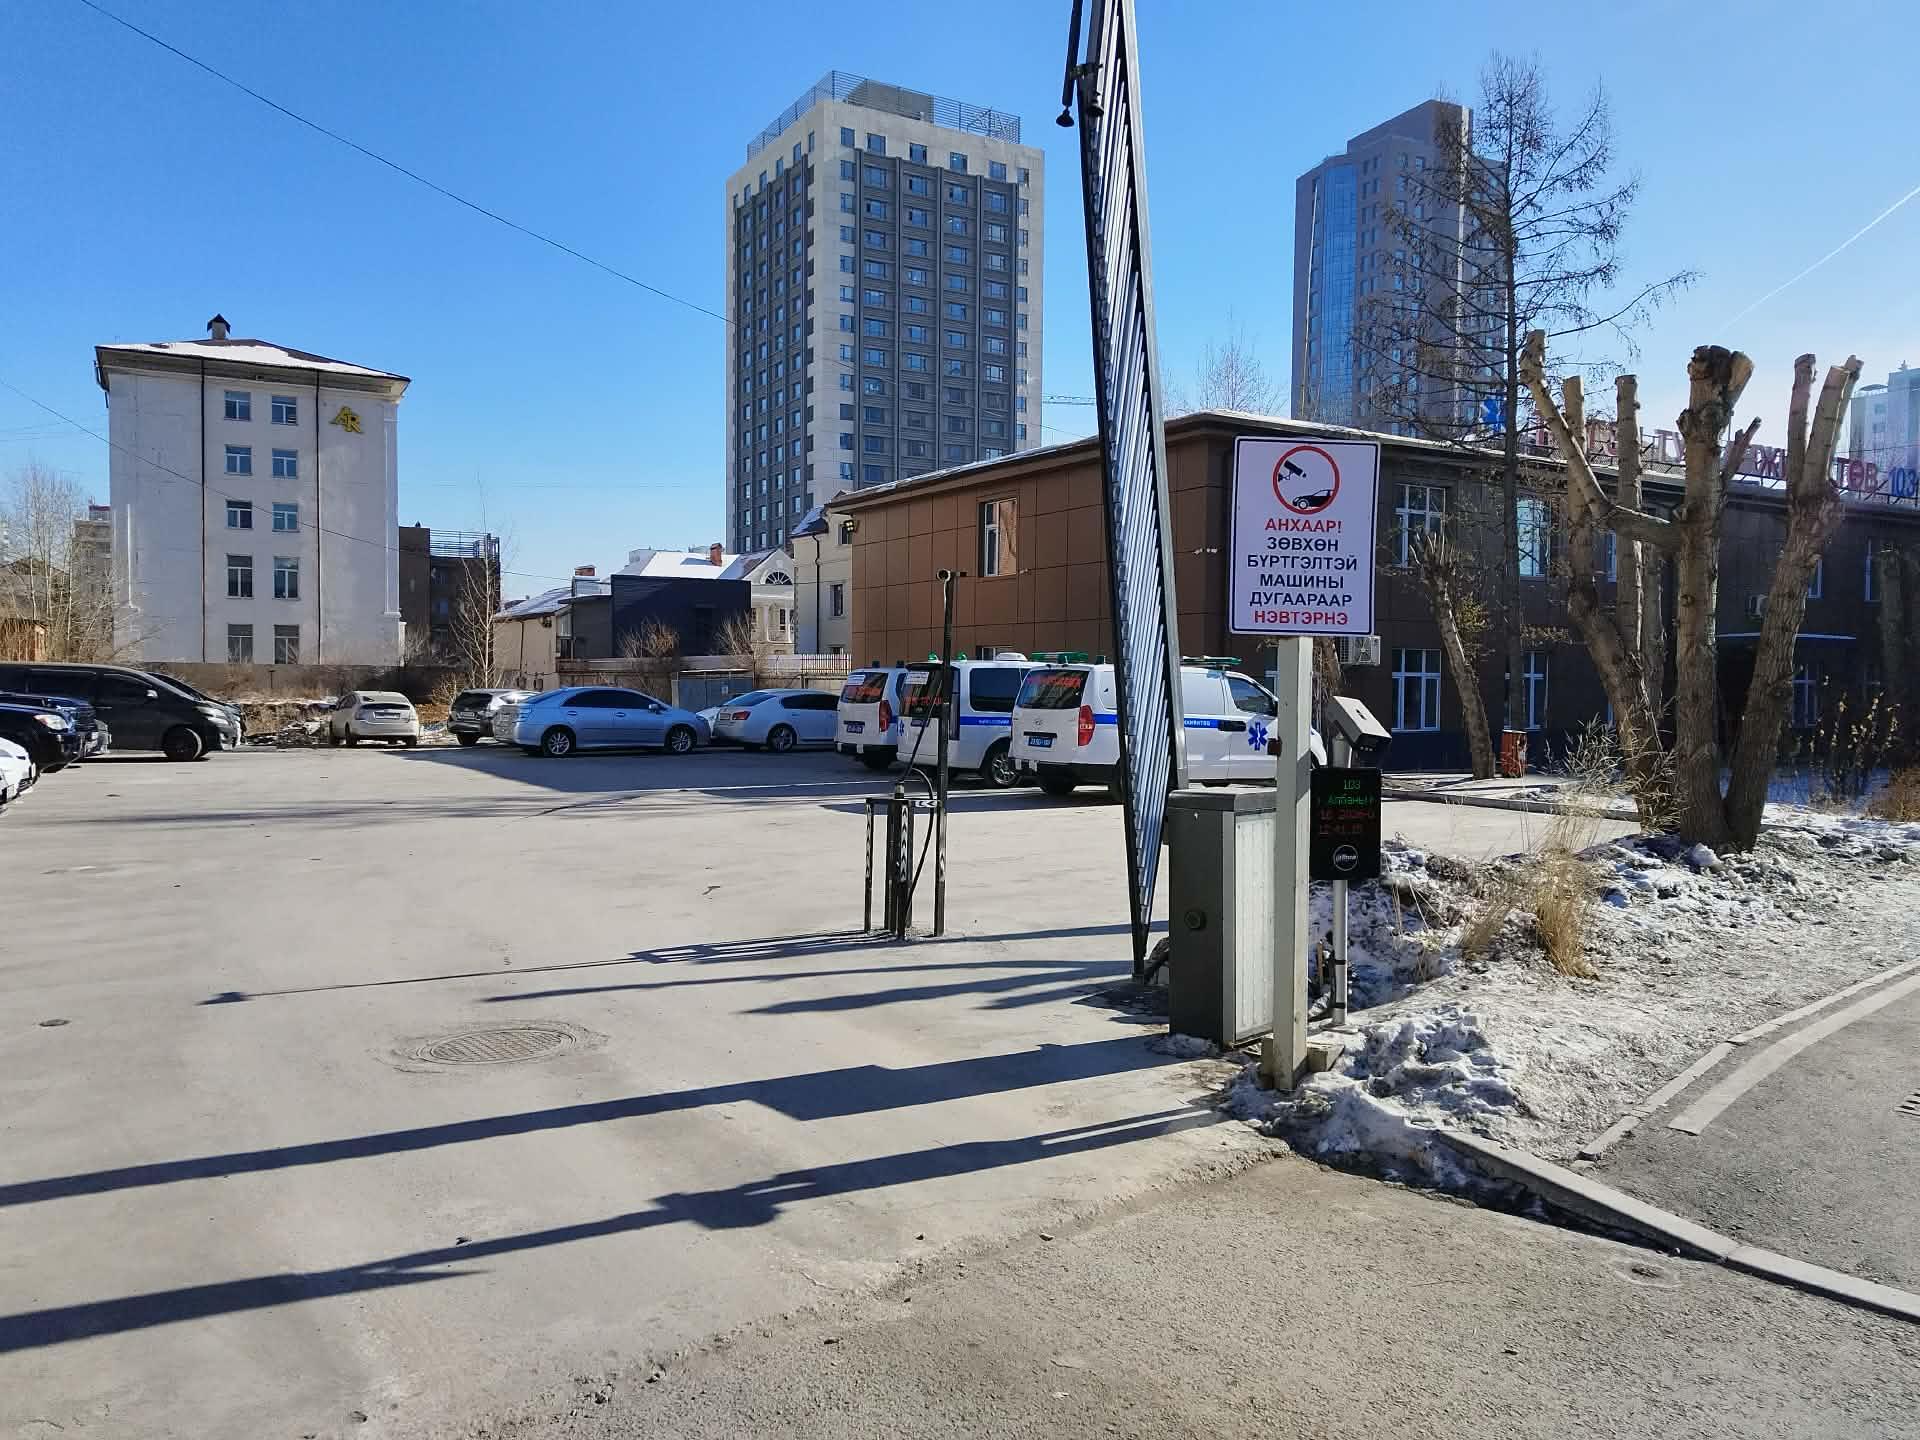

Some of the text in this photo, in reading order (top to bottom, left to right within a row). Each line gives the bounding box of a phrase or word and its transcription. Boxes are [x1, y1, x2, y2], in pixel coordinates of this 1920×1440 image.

[1888, 466, 1916, 497] 103
[1265, 518, 1342, 533] АНХААР!
[1267, 536, 1339, 552] ЗӨВХӨН
[1247, 554, 1357, 571] БҮРТГЭЛТЭЙ
[1260, 574, 1344, 589] МАШИНЫ
[1250, 591, 1353, 607] ДУГААРААР
[1254, 610, 1349, 625] НЭВТЭРНЭ
